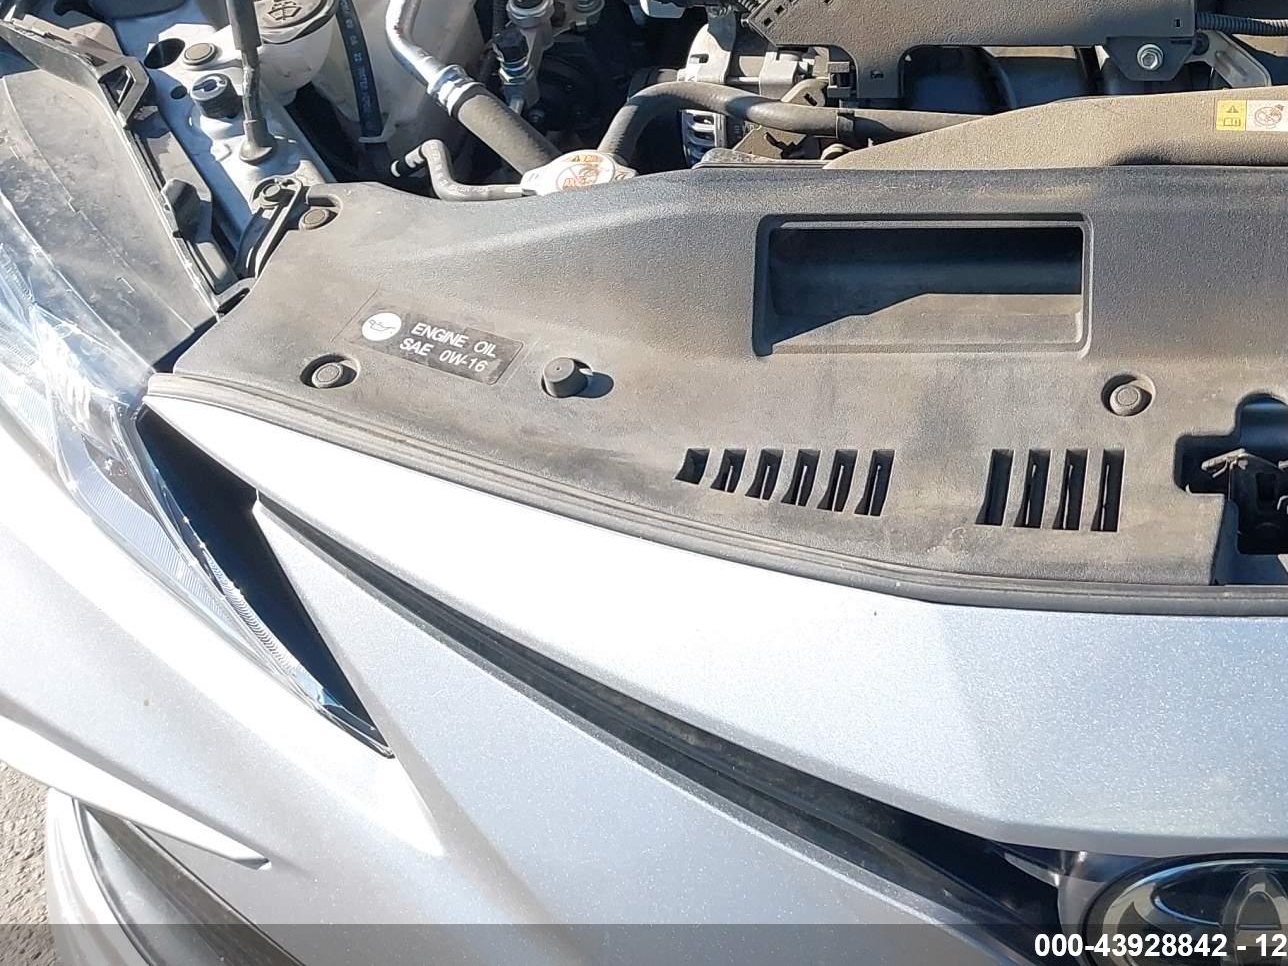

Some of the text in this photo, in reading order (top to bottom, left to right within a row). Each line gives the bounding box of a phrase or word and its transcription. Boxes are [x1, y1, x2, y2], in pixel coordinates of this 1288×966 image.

[399, 337, 488, 373] SAE 0W-16
[411, 322, 497, 358] ENGINE OIL
